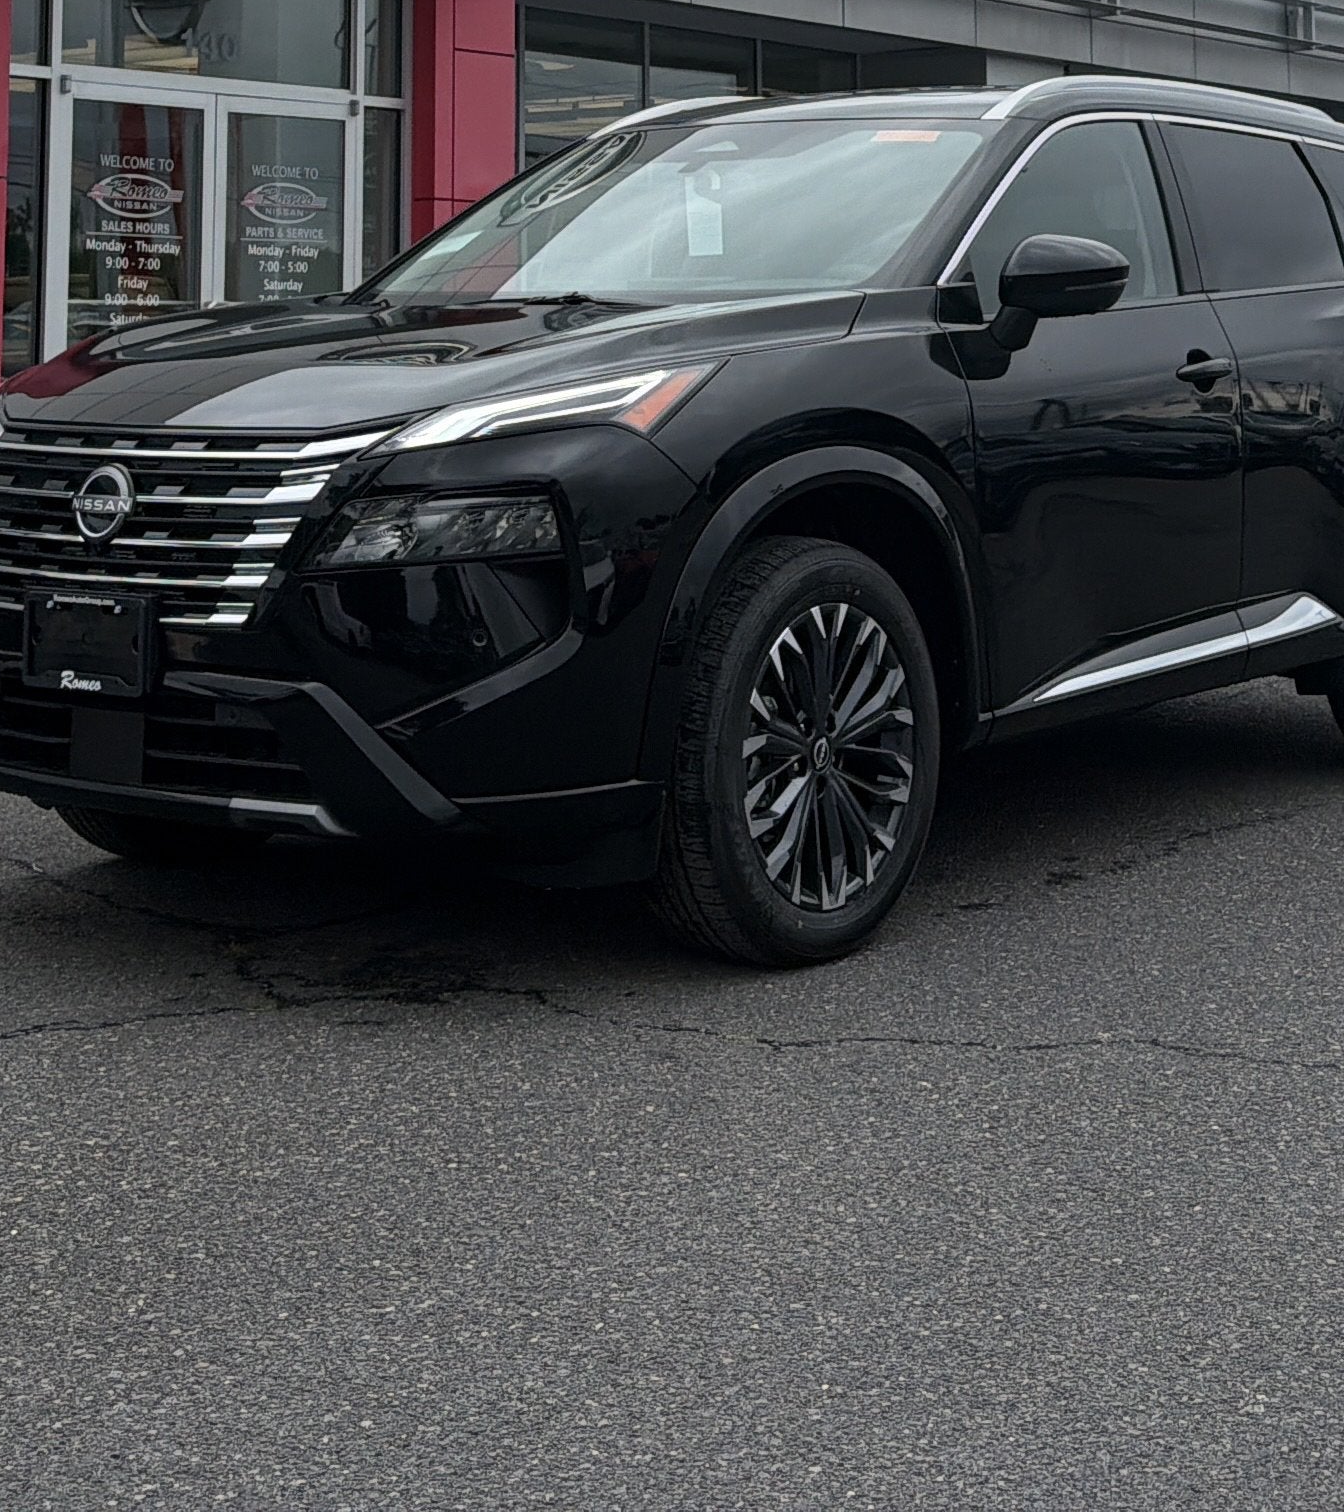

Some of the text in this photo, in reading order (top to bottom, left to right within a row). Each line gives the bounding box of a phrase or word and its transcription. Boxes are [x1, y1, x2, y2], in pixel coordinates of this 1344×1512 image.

[99, 153, 175, 172] WELCOME TO
[251, 164, 319, 180] WELCOME TO
[107, 177, 169, 199] Romeo
[258, 186, 314, 205] Romeo
[114, 200, 157, 211] NISSAN
[265, 207, 304, 217] NISSAN
[101, 220, 170, 235] SALES HOURS
[245, 226, 324, 240] PARTS & SERVICE
[85, 238, 127, 254] Monday
[135, 240, 181, 257] Thursday
[247, 243, 285, 259] Monday
[291, 245, 320, 260] Friday
[105, 256, 129, 269] 9:00
[137, 258, 161, 271] 7:00
[258, 260, 280, 273] 7:00
[287, 261, 309, 274] 5:00
[118, 276, 149, 291] Friday
[264, 278, 303, 293] Saturday
[104, 293, 129, 306] 9:00
[136, 293, 160, 307] 6:00
[72, 497, 131, 512] NISSAN
[60, 670, 102, 692] Romeo
